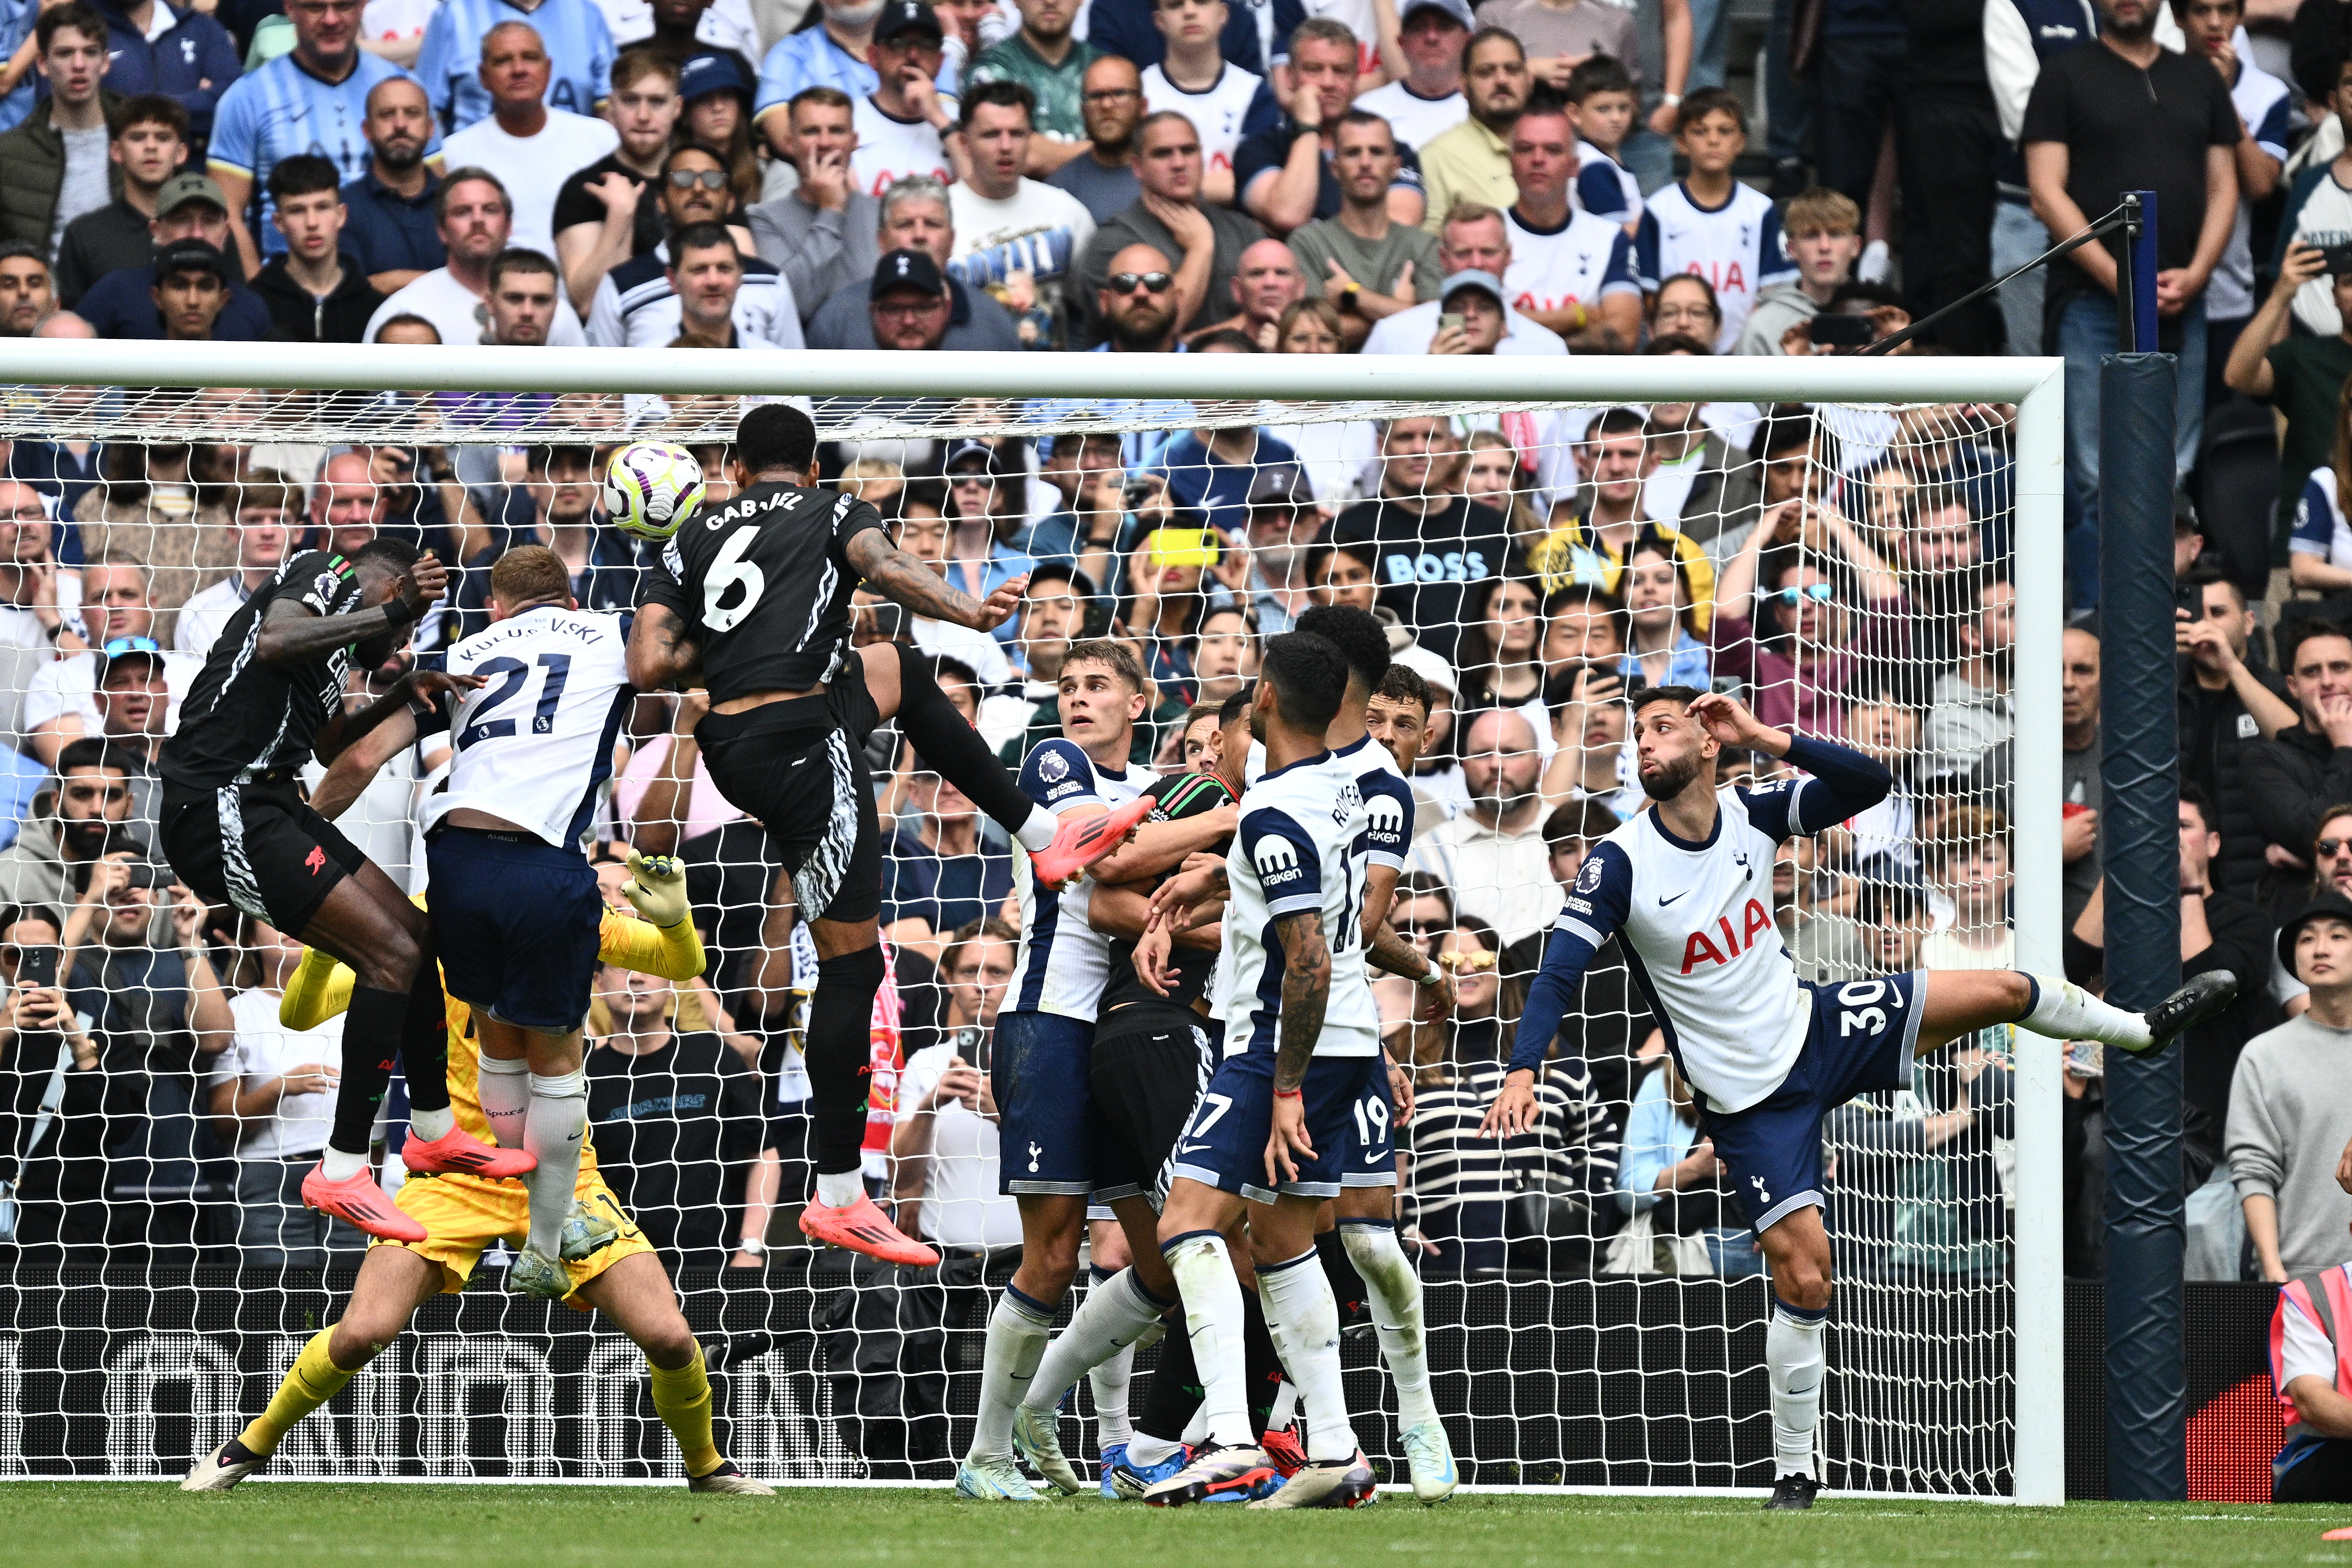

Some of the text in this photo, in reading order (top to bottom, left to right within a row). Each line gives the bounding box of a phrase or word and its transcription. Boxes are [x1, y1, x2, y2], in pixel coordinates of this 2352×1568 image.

[701, 525, 765, 632] 6
[1385, 551, 1490, 584] BOSS
[459, 617, 604, 661] KULUSVSKI
[457, 653, 572, 753] 21
[1057, 780, 1078, 791] room
[1058, 785, 1084, 796] racism
[1367, 830, 1401, 843] raken
[1261, 868, 1303, 887] kraken
[1333, 828, 1370, 954] 17
[1569, 903, 1593, 916] racism
[1573, 897, 1592, 909] room
[1680, 898, 1772, 975] AIA
[1838, 980, 1887, 1037] 30
[485, 1107, 525, 1118] Spurs
[606, 1094, 707, 1121] STAR WARS
[1353, 1095, 1389, 1145] 19
[596, 1194, 630, 1225] 1
